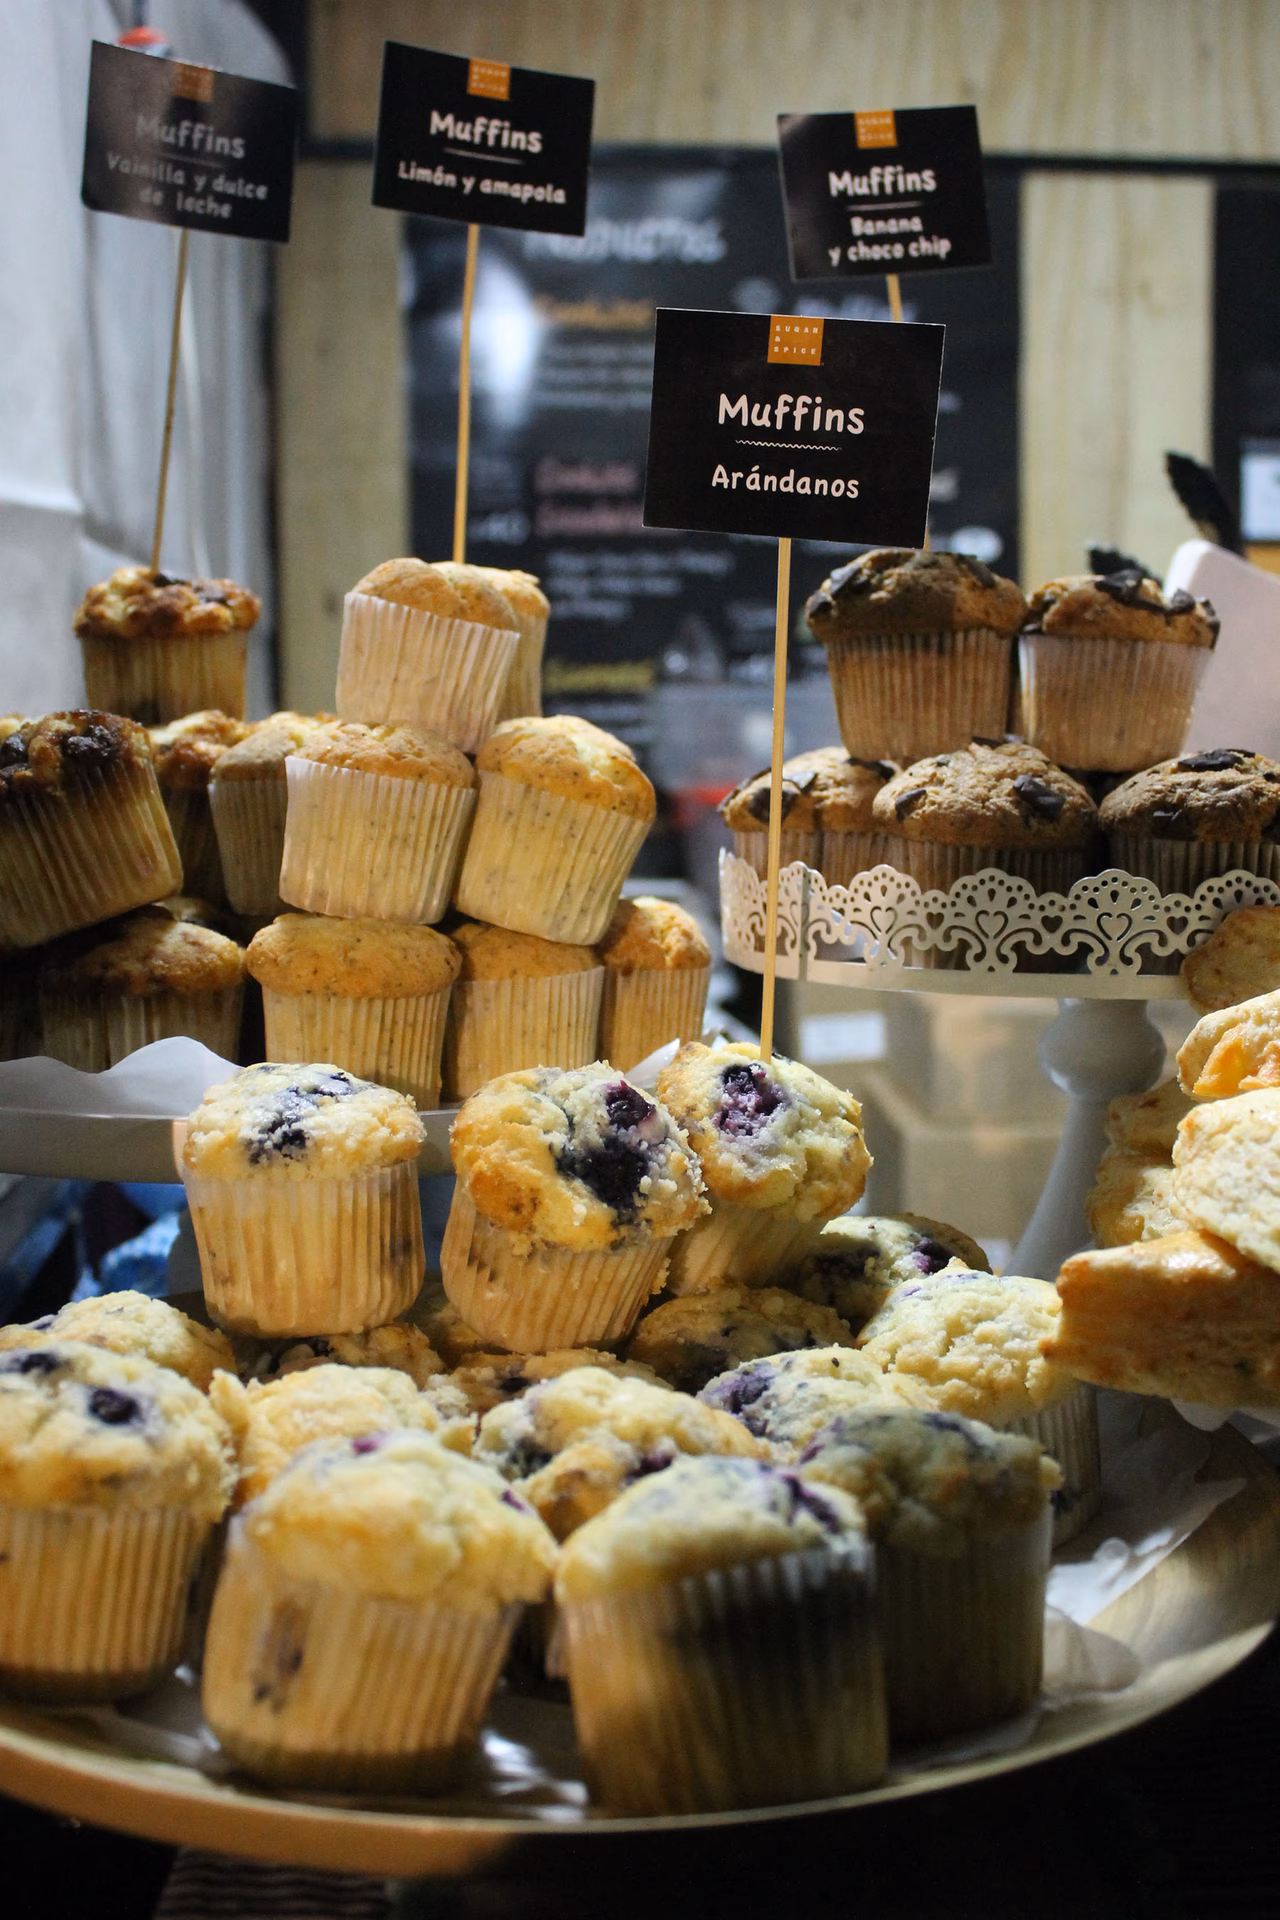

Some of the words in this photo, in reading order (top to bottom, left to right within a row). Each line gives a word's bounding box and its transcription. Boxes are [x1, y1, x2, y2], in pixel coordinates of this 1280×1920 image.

[136, 115, 245, 159] Muffins
[430, 110, 543, 153] Muffins
[193, 174, 207, 193] y
[211, 174, 269, 200] dulce
[398, 162, 457, 188] Limón
[462, 176, 475, 195] y
[479, 179, 566, 204] amapola
[828, 165, 937, 197] Muffins
[176, 191, 233, 219] leche
[850, 216, 923, 236] Banana
[828, 247, 842, 268] y
[847, 240, 905, 262] choco
[908, 235, 952, 261] chip
[775, 324, 819, 334] SUGAR
[773, 345, 817, 355] SPICE
[718, 393, 865, 434] Muffins
[711, 464, 860, 499] Arándanos
